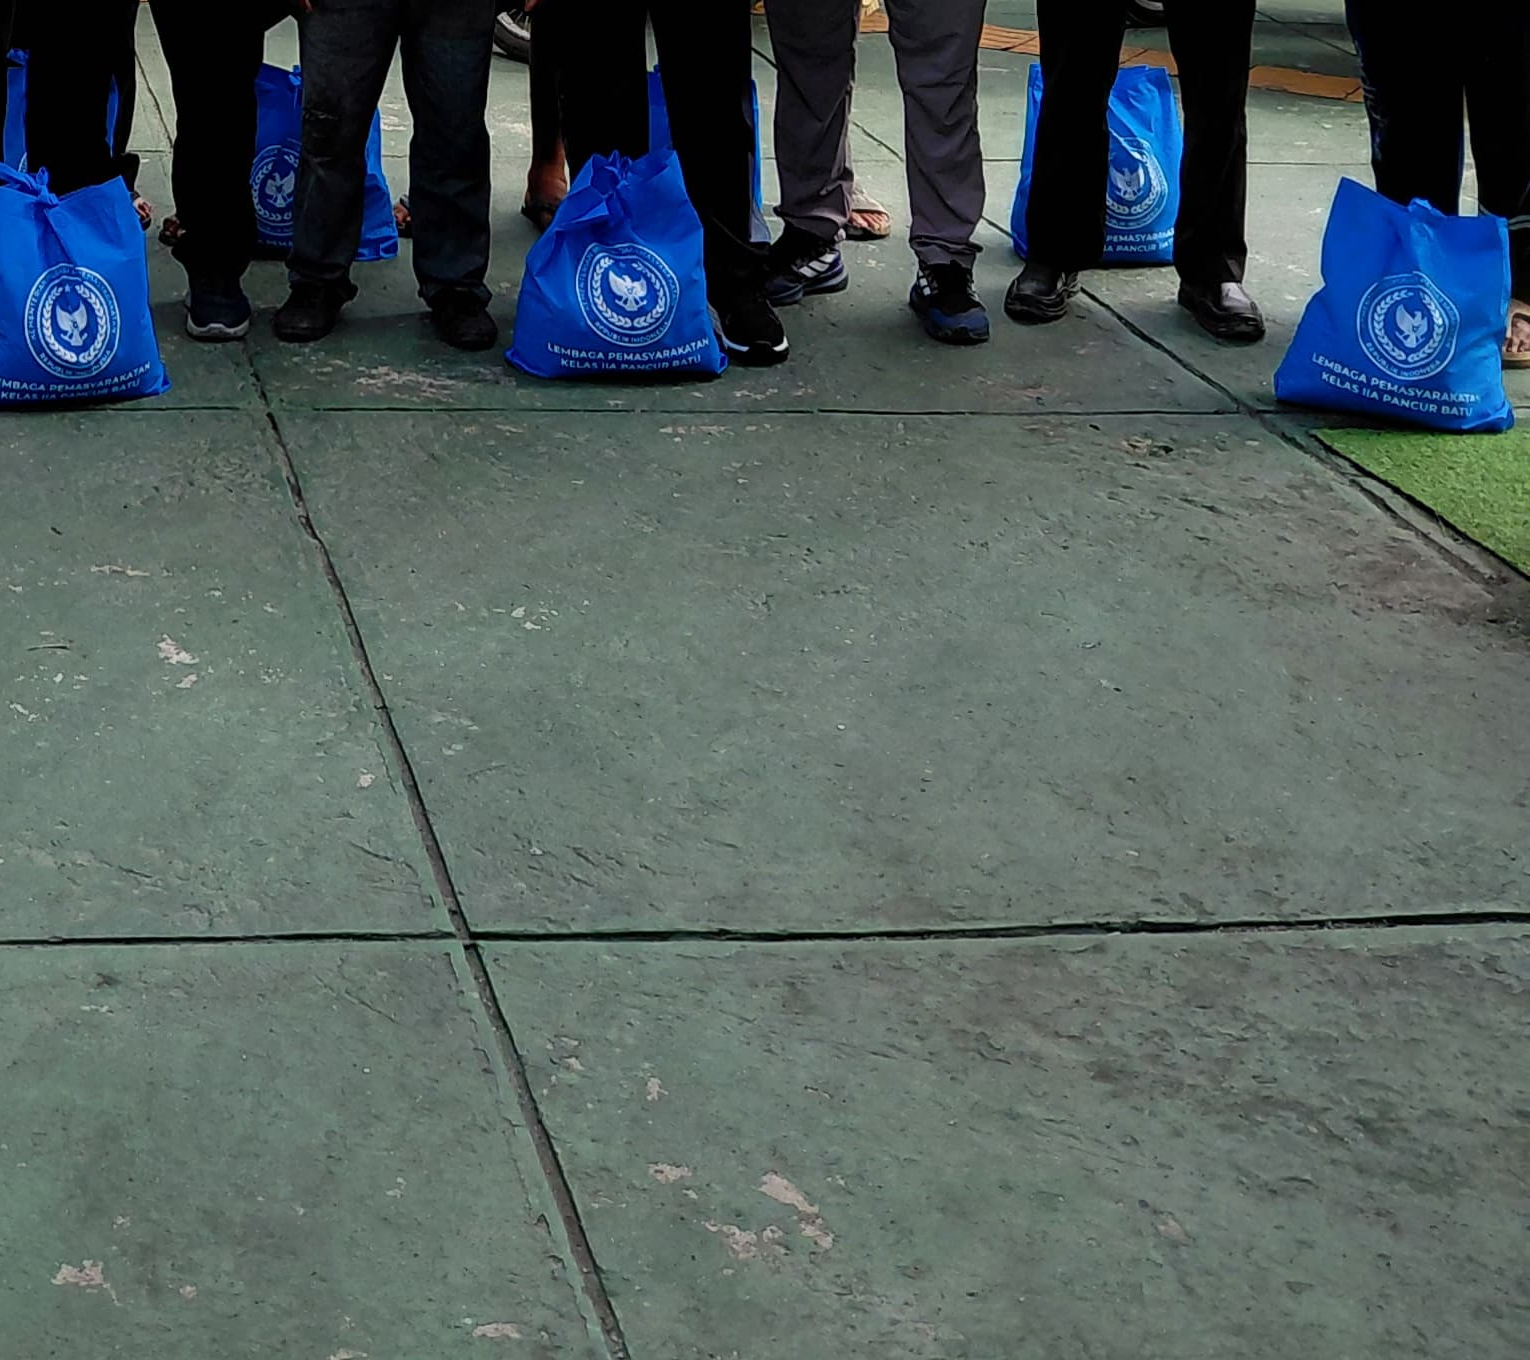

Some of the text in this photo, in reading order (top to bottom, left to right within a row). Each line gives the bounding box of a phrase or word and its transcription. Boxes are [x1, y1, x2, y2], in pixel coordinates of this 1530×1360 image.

[547, 337, 710, 361] LEMBAGA PEMASYARAKATAN
[561, 358, 598, 369] KELAS
[672, 354, 702, 368] BATU
[49, 361, 151, 392] PEMASYARAKATAN
[1311, 352, 1367, 384] LEMBAGA
[1, 390, 38, 401] KELAS
[111, 378, 141, 395] BATU
[1322, 372, 1359, 394] KELAS
[1363, 388, 1379, 401] IIA
[1383, 394, 1437, 414] PANCUR
